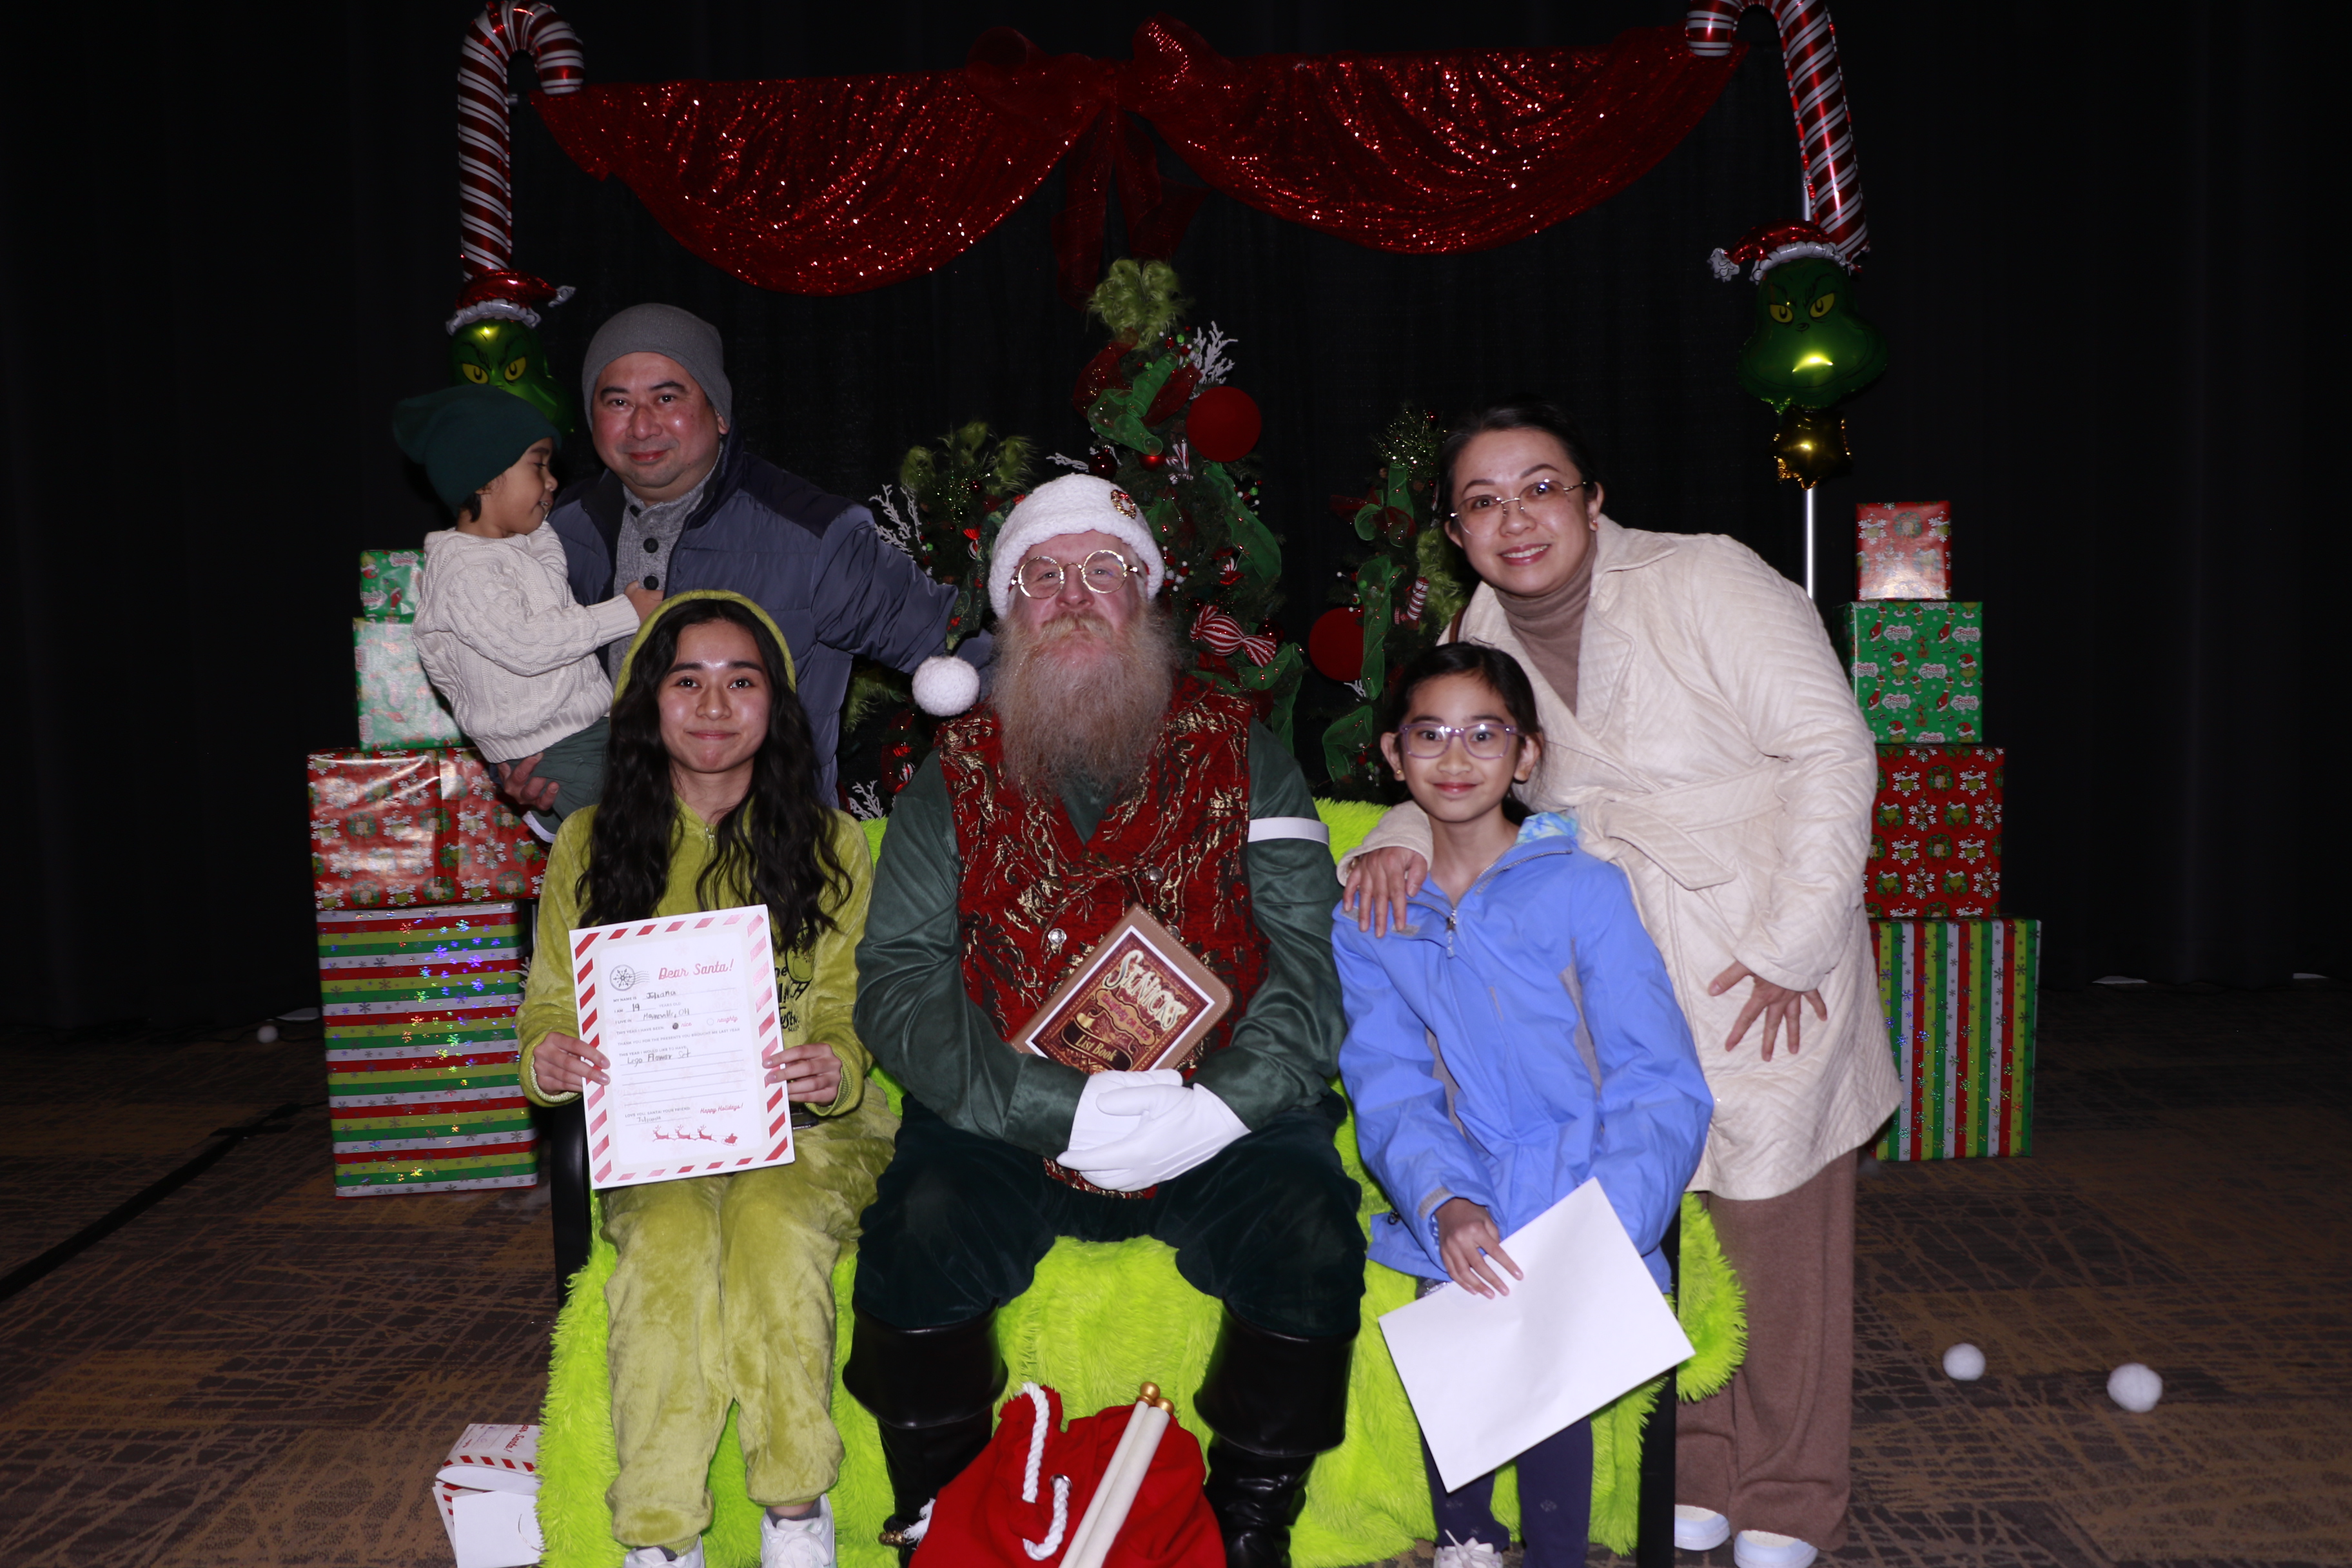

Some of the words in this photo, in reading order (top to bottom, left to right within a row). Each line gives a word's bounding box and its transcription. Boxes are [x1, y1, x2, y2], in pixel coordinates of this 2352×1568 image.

[658, 968, 689, 980] Dear
[693, 959, 734, 975] Santa!
[678, 1008, 690, 1016] OH
[717, 1015, 738, 1024] naughty
[1074, 1034, 1093, 1050] List
[1092, 1043, 1119, 1062] Book
[627, 1057, 643, 1067] Lego
[678, 1048, 691, 1059] Set
[718, 1102, 744, 1112] Holidays!
